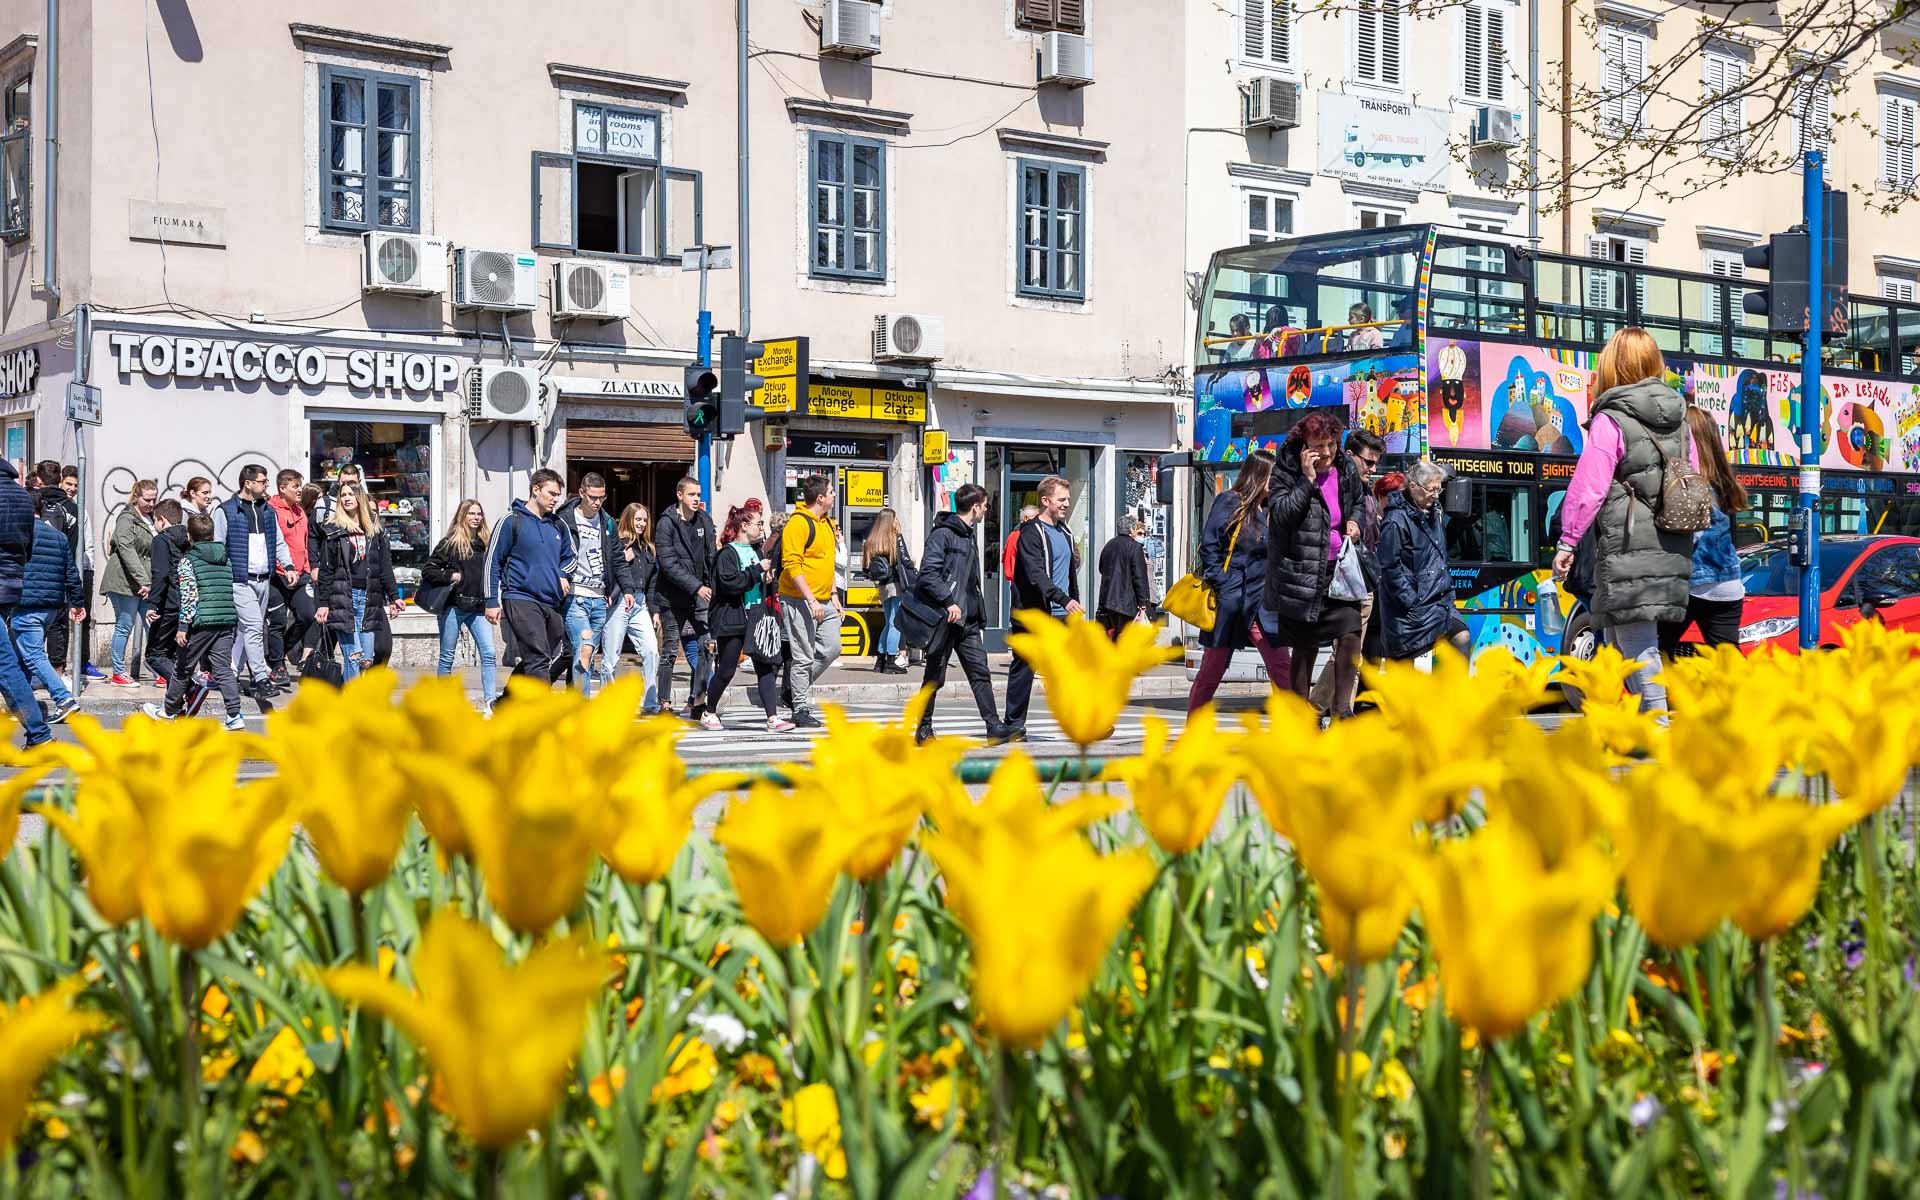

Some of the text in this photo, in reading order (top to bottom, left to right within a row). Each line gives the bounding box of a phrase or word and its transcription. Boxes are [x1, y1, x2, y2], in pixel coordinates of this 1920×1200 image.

[1360, 99, 1411, 116] TRANSPORTI
[582, 107, 648, 123] Aprtment
[609, 120, 642, 131] rooms
[153, 216, 204, 229] FIUMARA
[772, 347, 792, 355] Money
[110, 333, 460, 392] TOBACCO SHOP
[757, 354, 793, 367] Exchange
[601, 381, 682, 396] ZLATARNA
[764, 382, 786, 393] Otkup
[821, 387, 853, 399] Money
[1696, 380, 1720, 393] HOMO
[763, 392, 787, 405] Zlata
[808, 395, 855, 411] xchange
[884, 392, 914, 403] Otkup
[883, 402, 915, 415] Zlata
[814, 441, 857, 456] Zajmovi
[1507, 461, 1534, 475] TOUR
[1736, 474, 1787, 488] SIGHTSEEING
[866, 488, 882, 497] ATM
